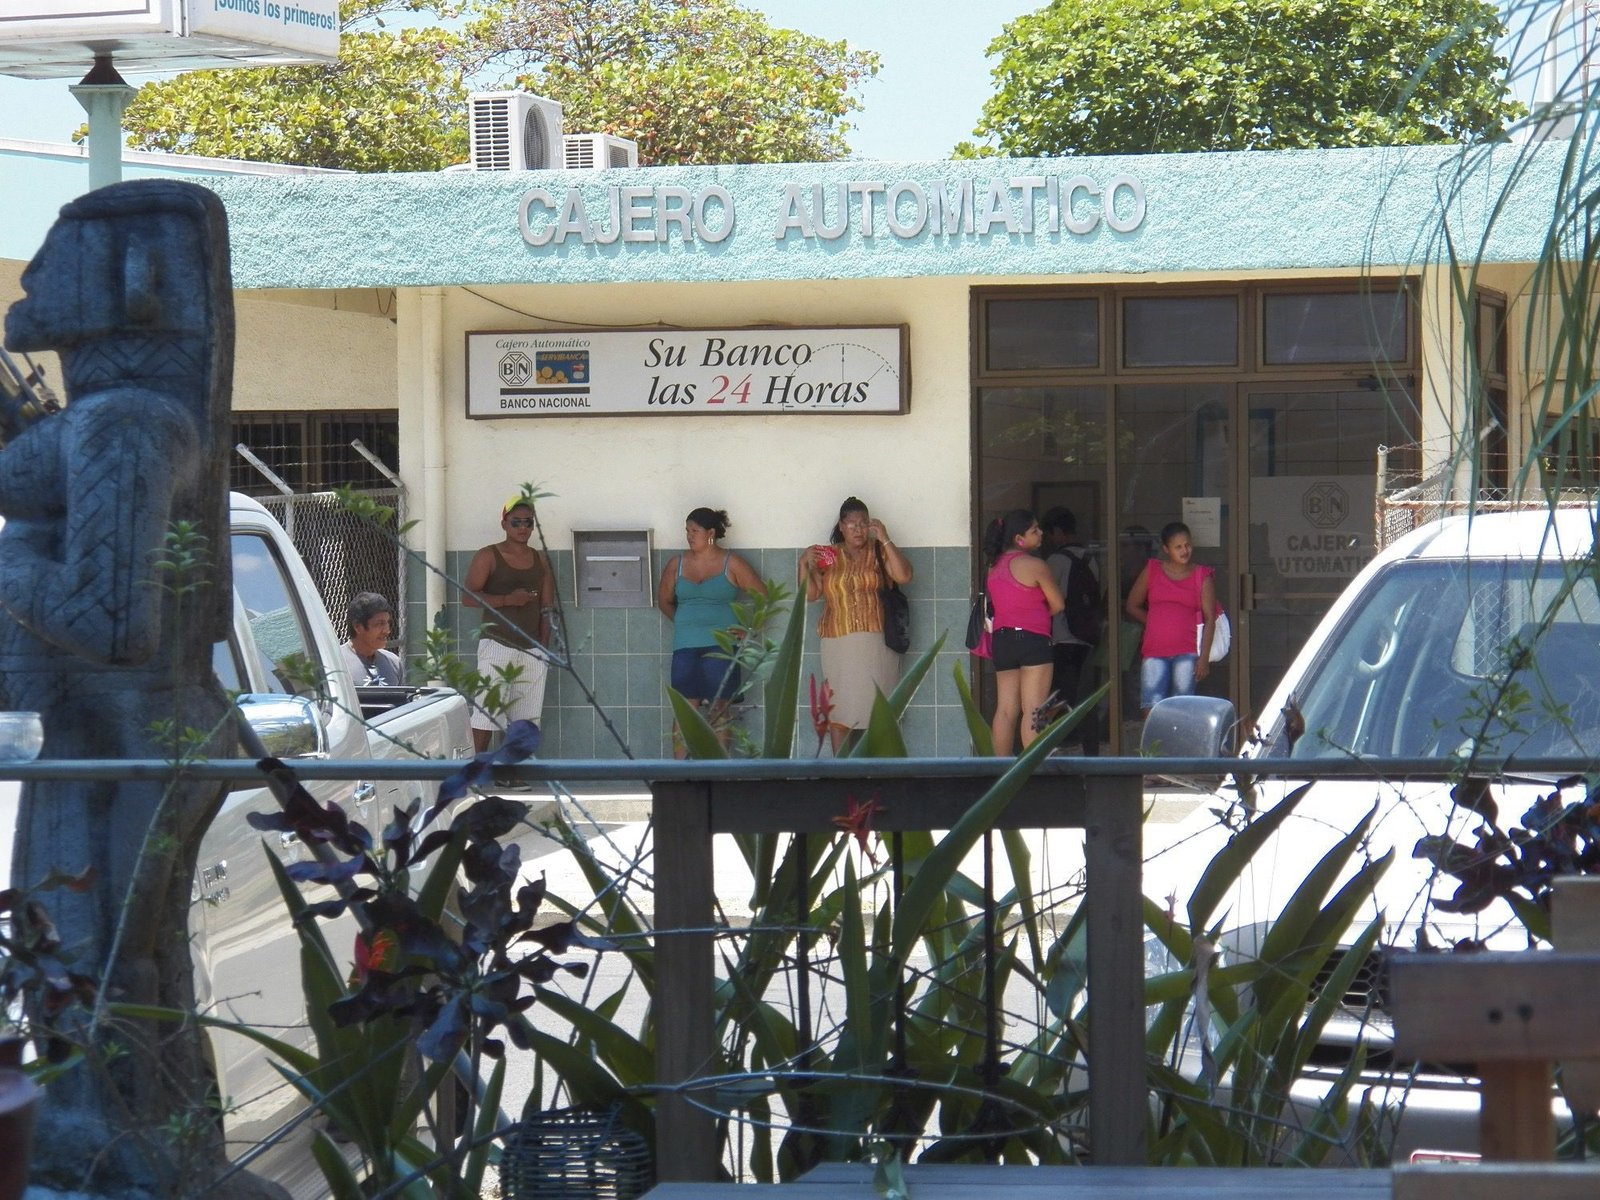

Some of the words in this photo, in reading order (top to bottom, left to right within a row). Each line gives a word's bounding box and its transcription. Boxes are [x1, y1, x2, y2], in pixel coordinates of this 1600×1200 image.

[264, 0, 281, 19] los
[284, 4, 336, 30] primeros!
[518, 184, 735, 246] CAJERO
[774, 174, 1147, 239] AUTOMATICO
[495, 339, 529, 350] Cajero
[530, 338, 591, 348] Automático
[644, 338, 687, 368] Su
[700, 337, 812, 367] Banco
[500, 398, 537, 409] BANCO
[538, 397, 591, 408] NACIONAL
[647, 375, 697, 405] las
[706, 373, 753, 404] 24
[762, 374, 870, 405] Horas
